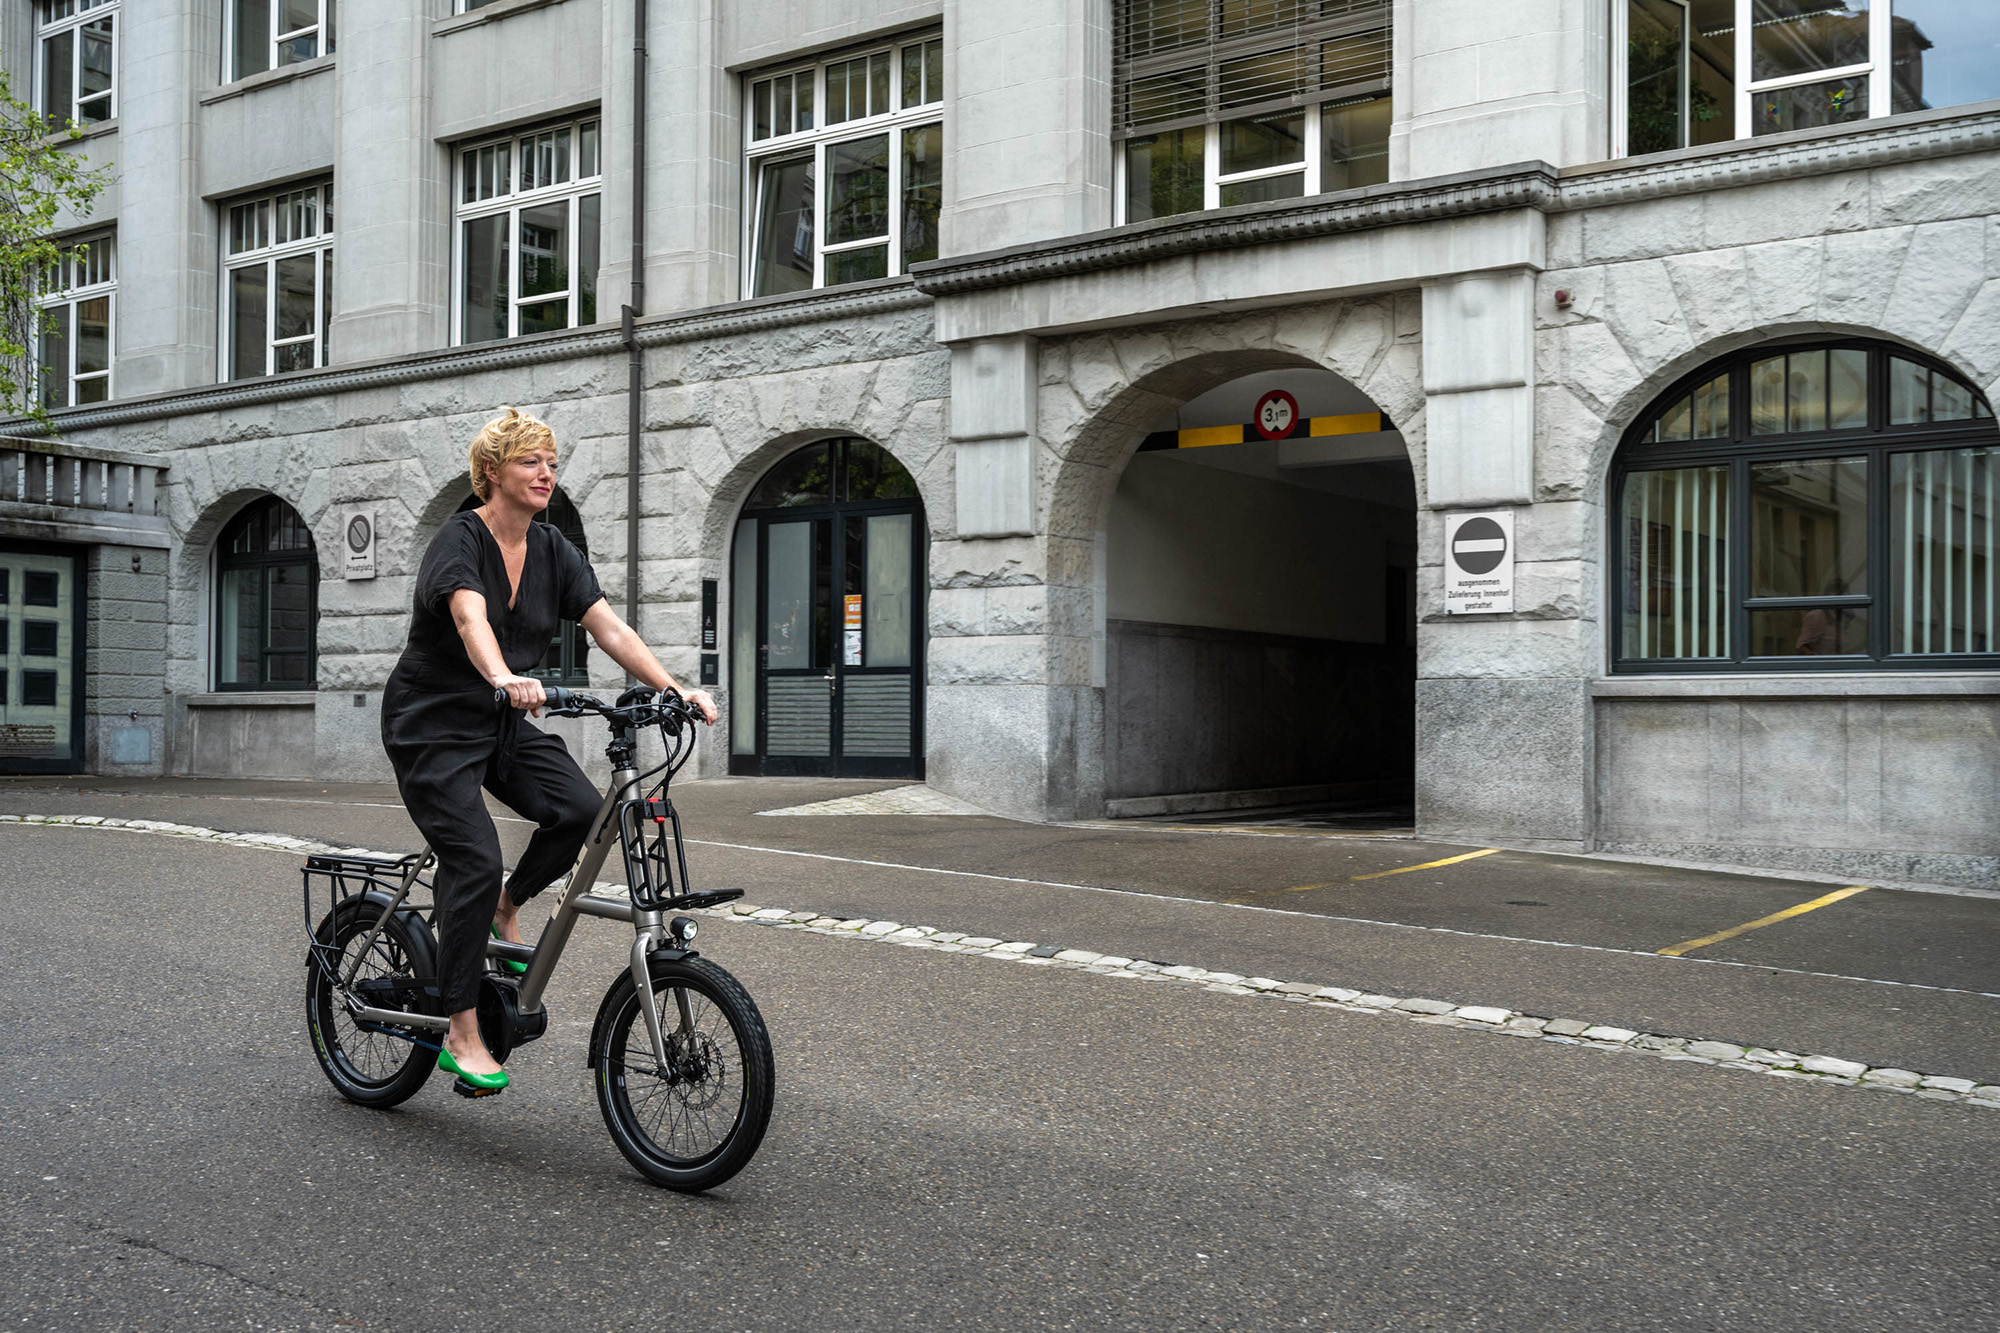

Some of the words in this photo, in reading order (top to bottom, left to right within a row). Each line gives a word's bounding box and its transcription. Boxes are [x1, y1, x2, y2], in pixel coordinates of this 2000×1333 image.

[1457, 579, 1500, 588] ausgenommen
[1448, 590, 1481, 599] Zulieferung
[1464, 602, 1493, 611] gestattet
